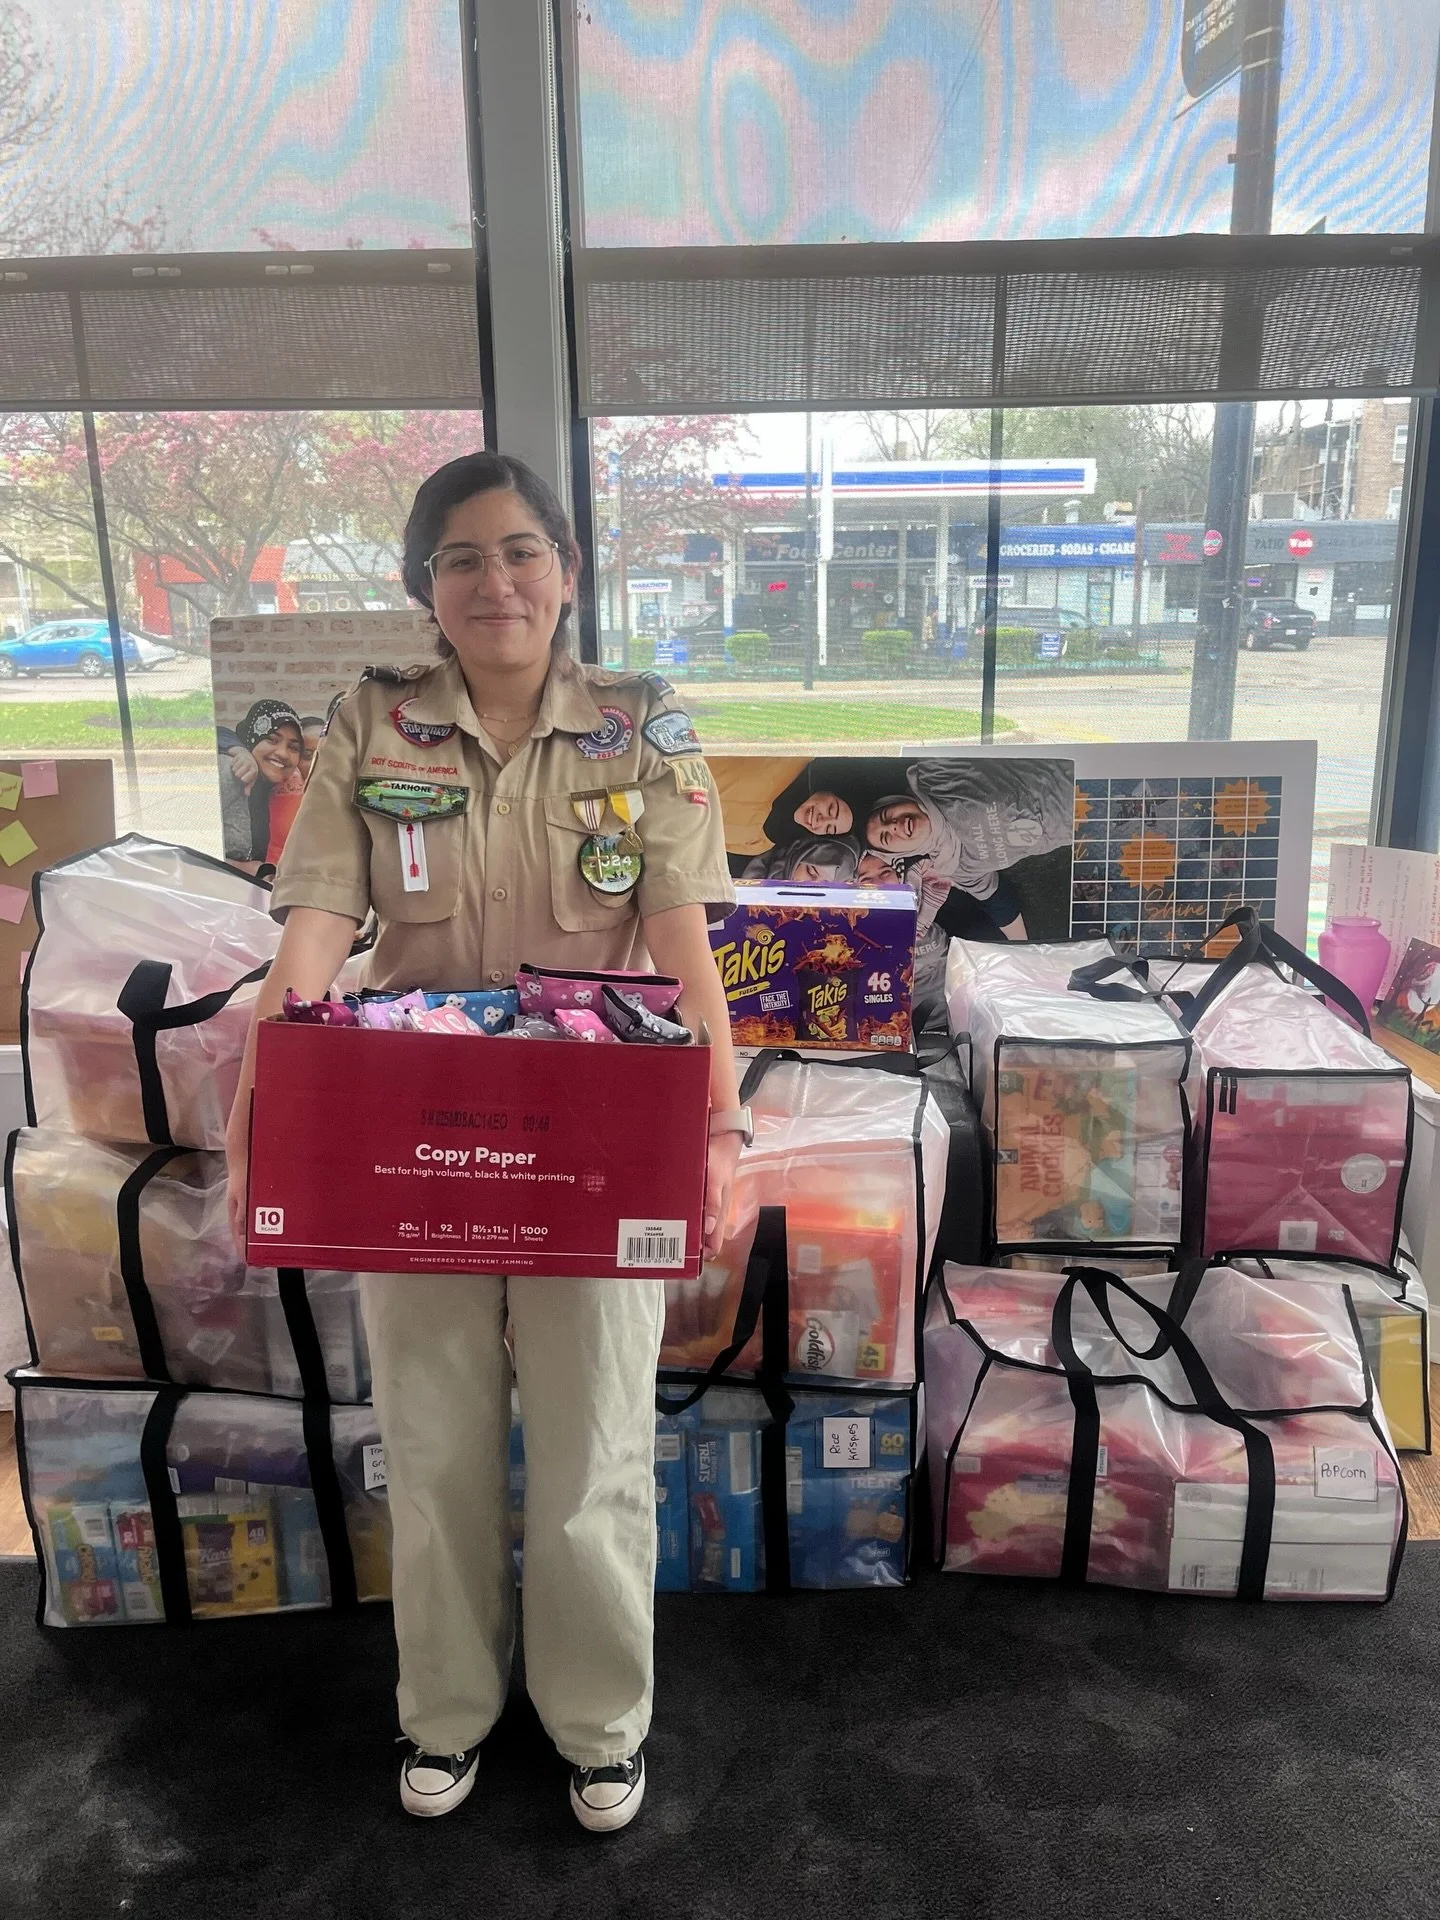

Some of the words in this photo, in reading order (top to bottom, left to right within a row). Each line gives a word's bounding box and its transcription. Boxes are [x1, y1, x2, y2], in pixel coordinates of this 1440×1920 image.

[1000, 544, 1054, 556] GROCERIES
[1061, 544, 1093, 556] SODAS
[1100, 542, 1136, 555] CIGARS
[400, 722, 452, 737] FORWARD
[371, 757, 385, 766] BOY
[388, 760, 416, 770] SCOUTS
[427, 766, 458, 775] AMERICA
[972, 824, 985, 841] ALL
[977, 843, 989, 859] WE
[712, 929, 785, 988] Takis
[867, 972, 891, 992] 46
[807, 976, 848, 1013] Takis
[864, 993, 893, 1004] SINGLES
[415, 1143, 470, 1167] Copy
[475, 1147, 537, 1168] Paper
[1041, 1112, 1064, 1198] COOKIES
[374, 1165, 396, 1175] Best
[397, 1166, 412, 1176] for
[413, 1168, 434, 1178] high
[435, 1169, 473, 1179] volume,
[475, 1171, 500, 1180] black
[502, 1172, 509, 1180] &
[510, 1172, 537, 1181] white
[538, 1173, 576, 1184] printing
[259, 1211, 280, 1226] 10
[431, 1232, 462, 1240] Brightness
[440, 1224, 453, 1232] 92
[493, 1225, 501, 1234] 11
[520, 1226, 549, 1236] 5000
[803, 1316, 827, 1372] Goldfish
[862, 1346, 878, 1369] 45
[829, 1433, 841, 1454] Rice
[881, 1432, 904, 1448] 60
[698, 1442, 711, 1483] TREATS
